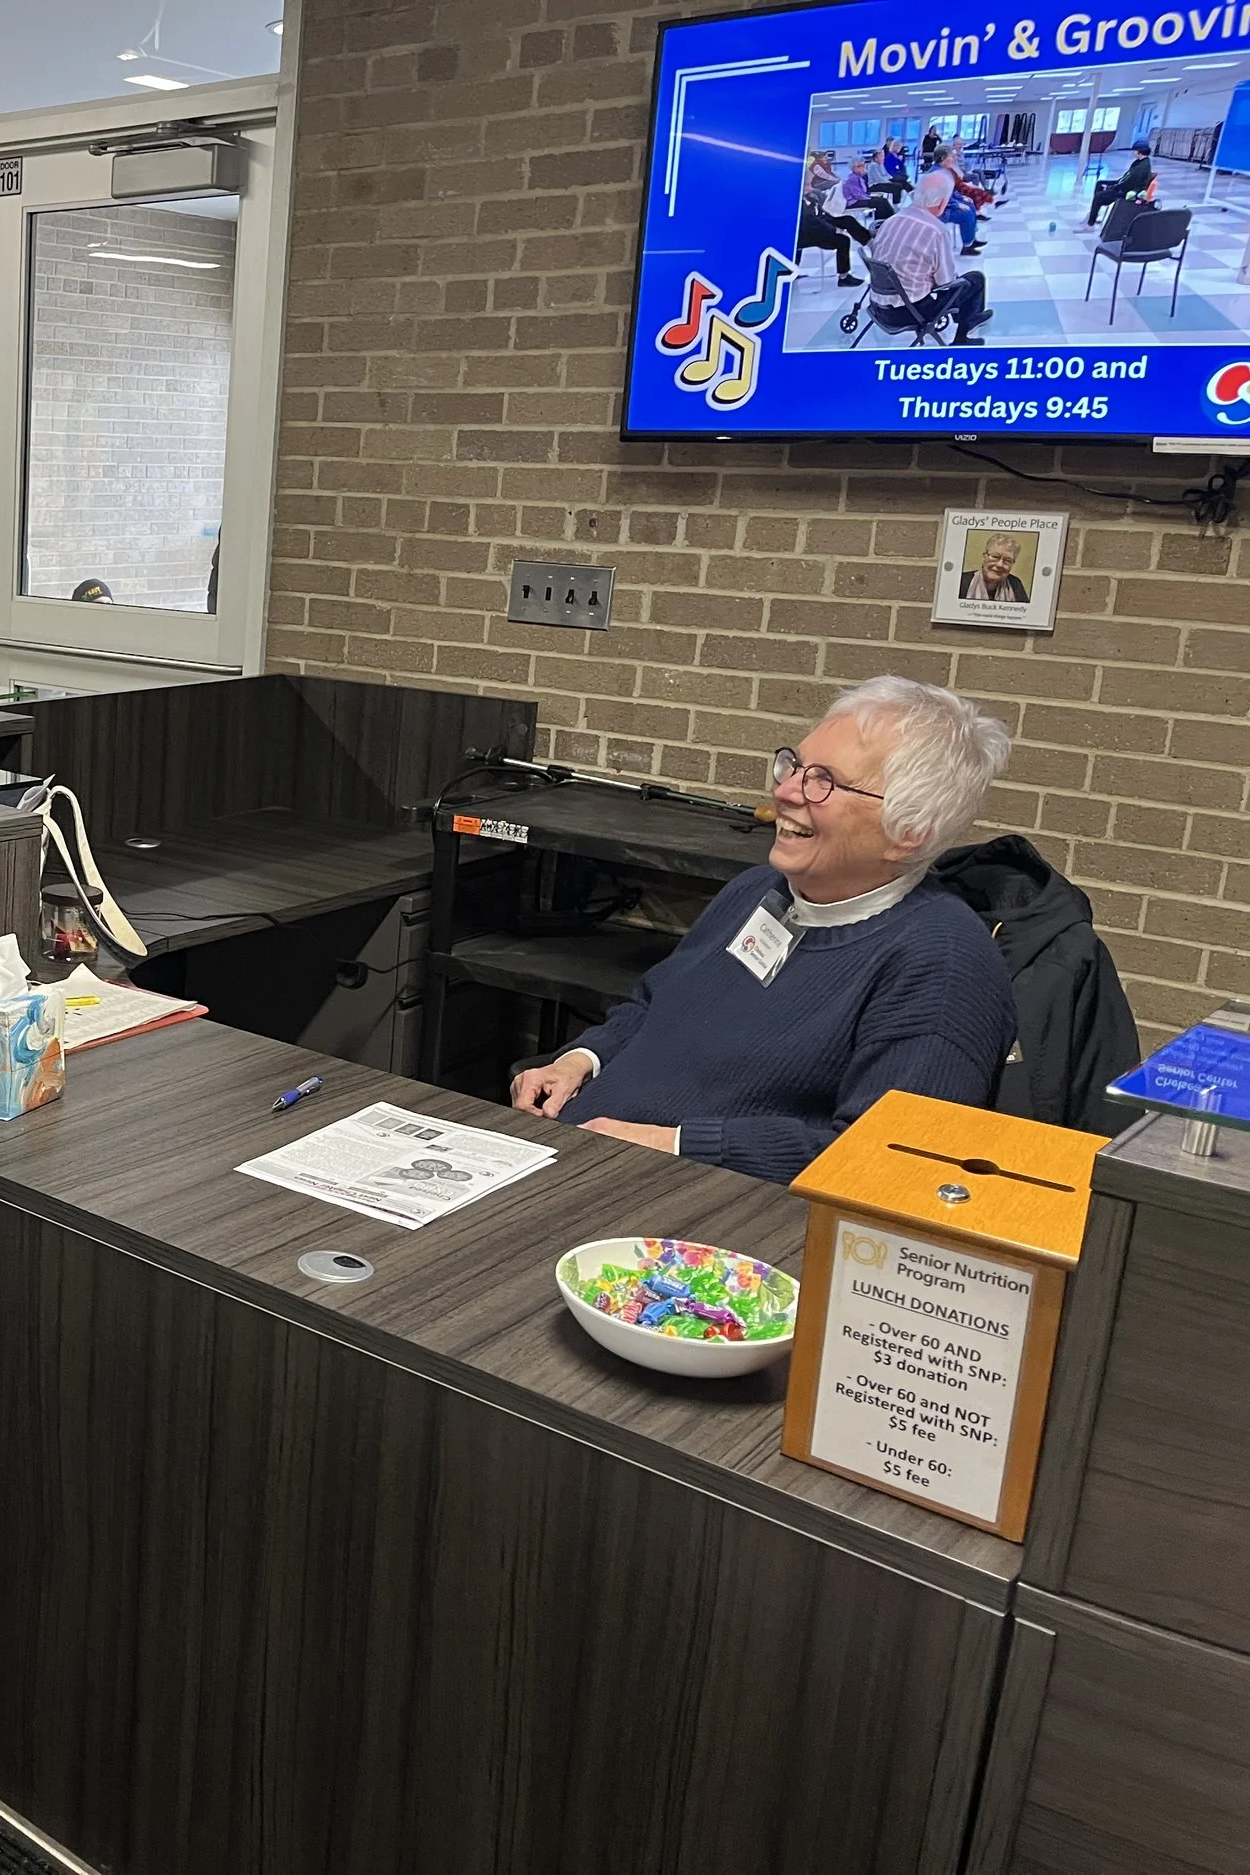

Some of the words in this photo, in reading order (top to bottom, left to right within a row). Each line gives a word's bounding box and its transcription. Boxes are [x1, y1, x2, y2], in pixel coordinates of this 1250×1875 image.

[1006, 19, 1040, 60] &
[0, 161, 19, 170] DOOR
[0, 171, 19, 192] 101
[874, 358, 998, 385] Tuesdays
[1005, 357, 1084, 379] 11:00
[1092, 355, 1147, 379] and
[899, 397, 1038, 424] Thursdays
[1045, 397, 1108, 419] 9:45
[991, 517, 1027, 529] People
[1030, 519, 1058, 530] Place
[959, 602, 980, 612] Gladys
[982, 603, 997, 611] Buck
[998, 604, 1027, 613] Kennedy
[897, 1263, 966, 1294] Program
[900, 1247, 951, 1271] Senior
[954, 1262, 1030, 1295] Nutrition
[853, 1280, 905, 1306] LUNCH
[910, 1297, 1010, 1337] DONATIONS
[843, 1325, 923, 1361] Registered
[928, 1351, 964, 1374] with
[968, 1366, 1007, 1387] SNP:
[879, 1322, 917, 1342] Over
[921, 1335, 940, 1350] 60
[943, 1343, 982, 1363] AND
[873, 1350, 891, 1366] $3
[896, 1359, 968, 1392] donation
[835, 1382, 915, 1419] Registered
[920, 1409, 955, 1433] with
[959, 1425, 998, 1447] SNP:
[856, 1375, 894, 1396] Over
[897, 1388, 916, 1403] 60
[920, 1398, 950, 1415] and
[954, 1407, 991, 1427] NOT
[888, 1415, 907, 1431] $5
[912, 1424, 937, 1442] fee
[876, 1440, 924, 1467] Under
[928, 1460, 952, 1477] 60:
[883, 1460, 901, 1476] $5
[906, 1469, 931, 1487] fee
